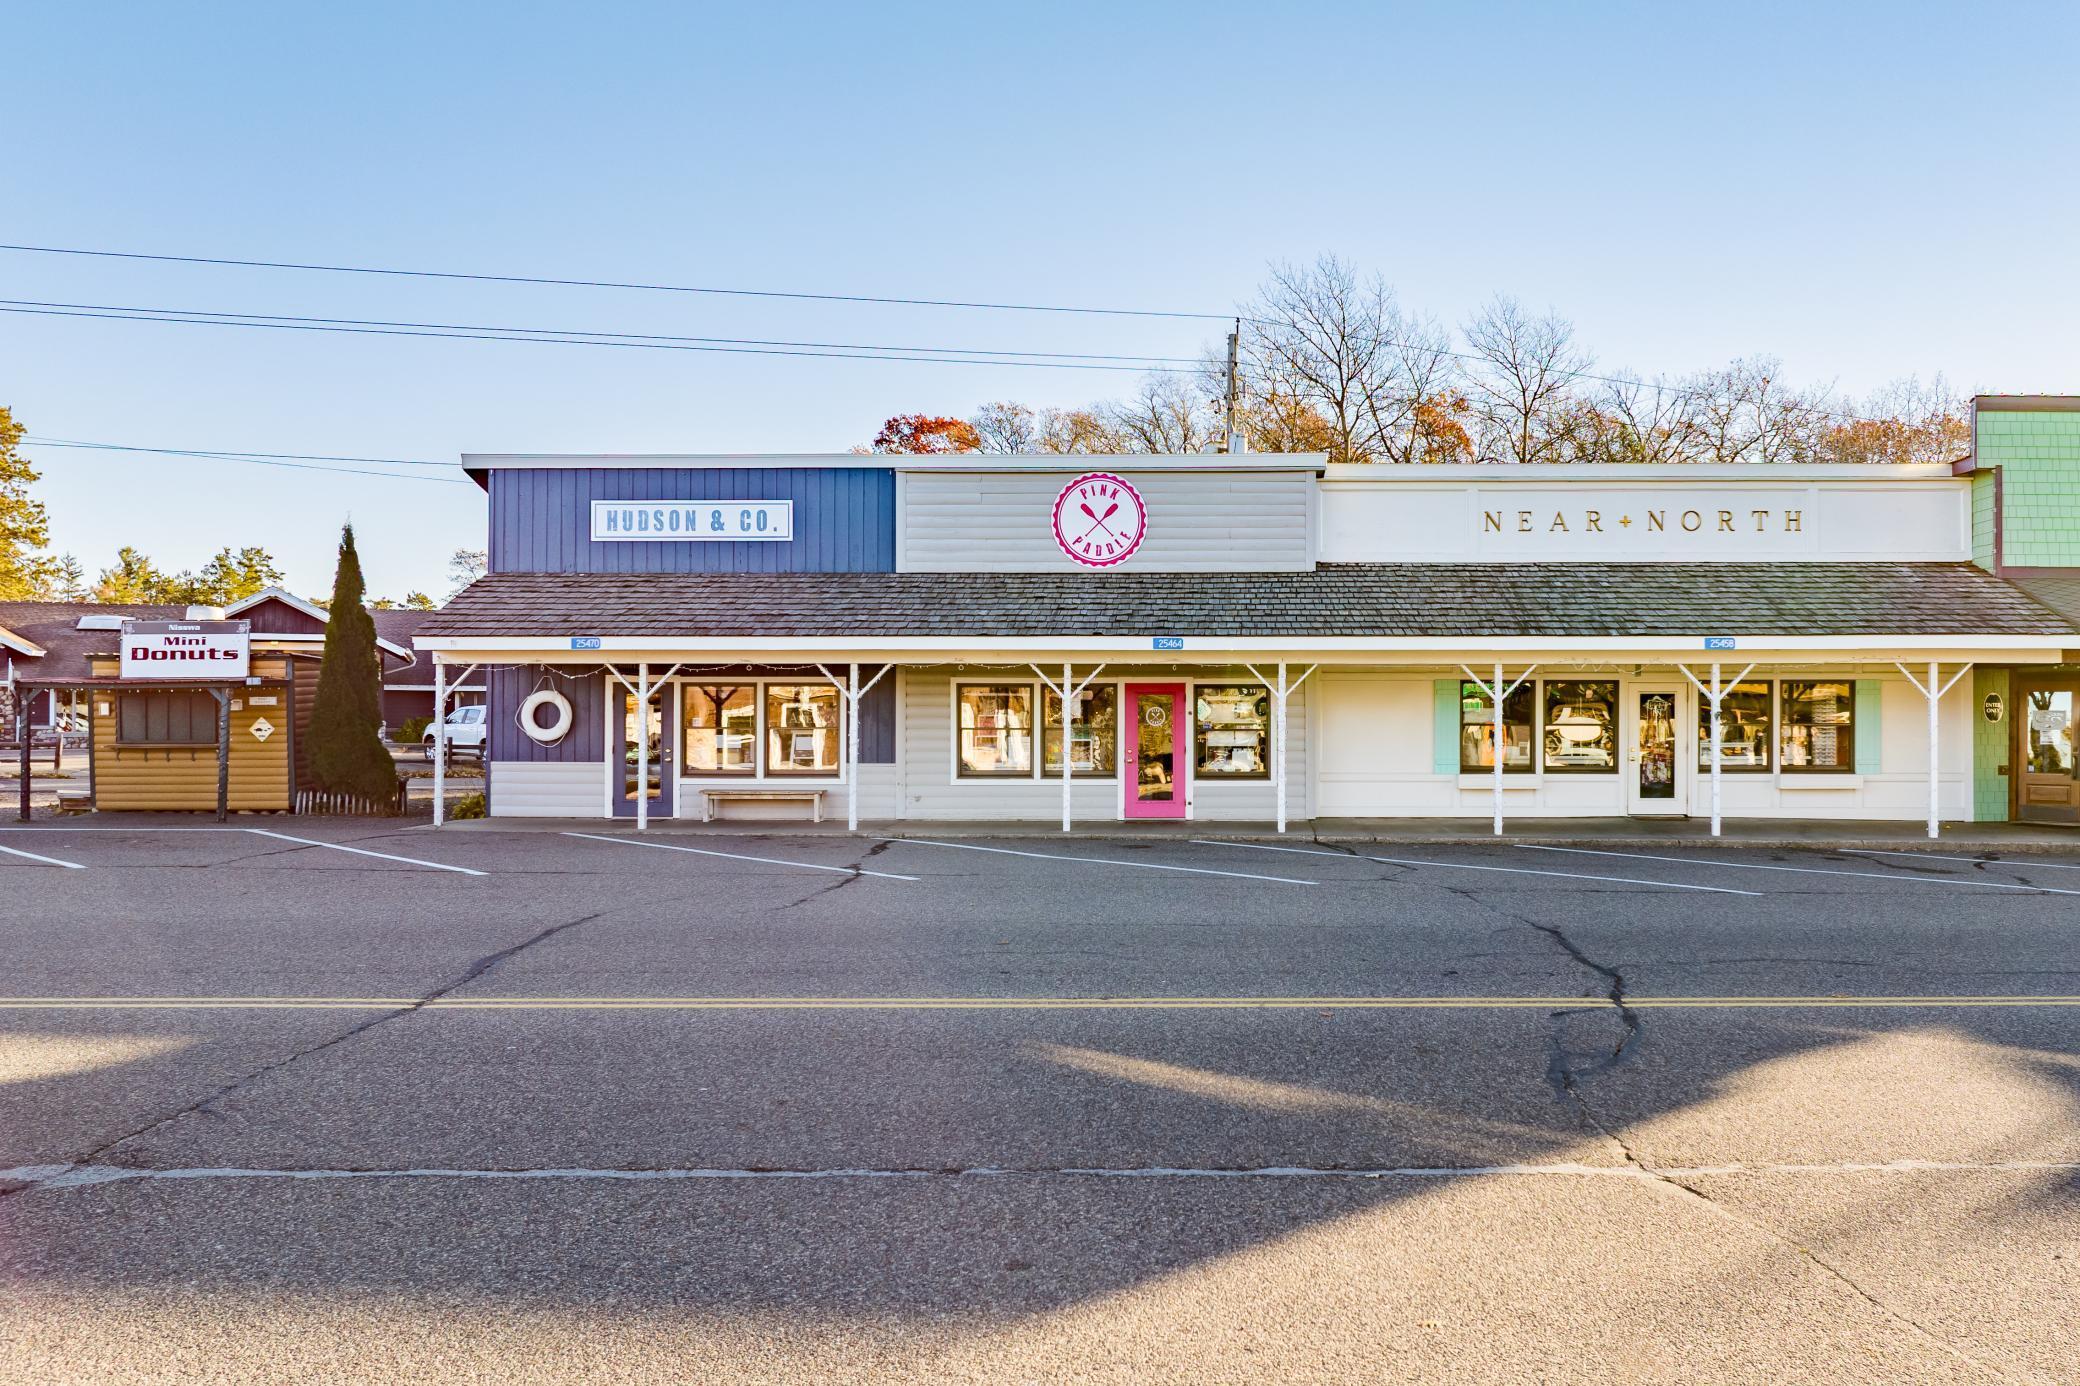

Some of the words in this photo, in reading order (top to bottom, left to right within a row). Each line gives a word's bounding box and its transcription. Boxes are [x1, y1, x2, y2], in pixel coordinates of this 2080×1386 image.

[1080, 484, 1120, 500] PINK
[606, 509, 696, 532] HUDSON
[710, 509, 725, 532] &
[739, 509, 778, 532] CO.
[1483, 510, 1604, 532] NEAR
[1647, 510, 1803, 532] NORTH
[1072, 531, 1132, 556] PADDLE
[164, 636, 207, 646] Mini
[576, 639, 600, 648] 25470
[1158, 638, 1183, 648] 25464
[131, 647, 239, 660] Donuts
